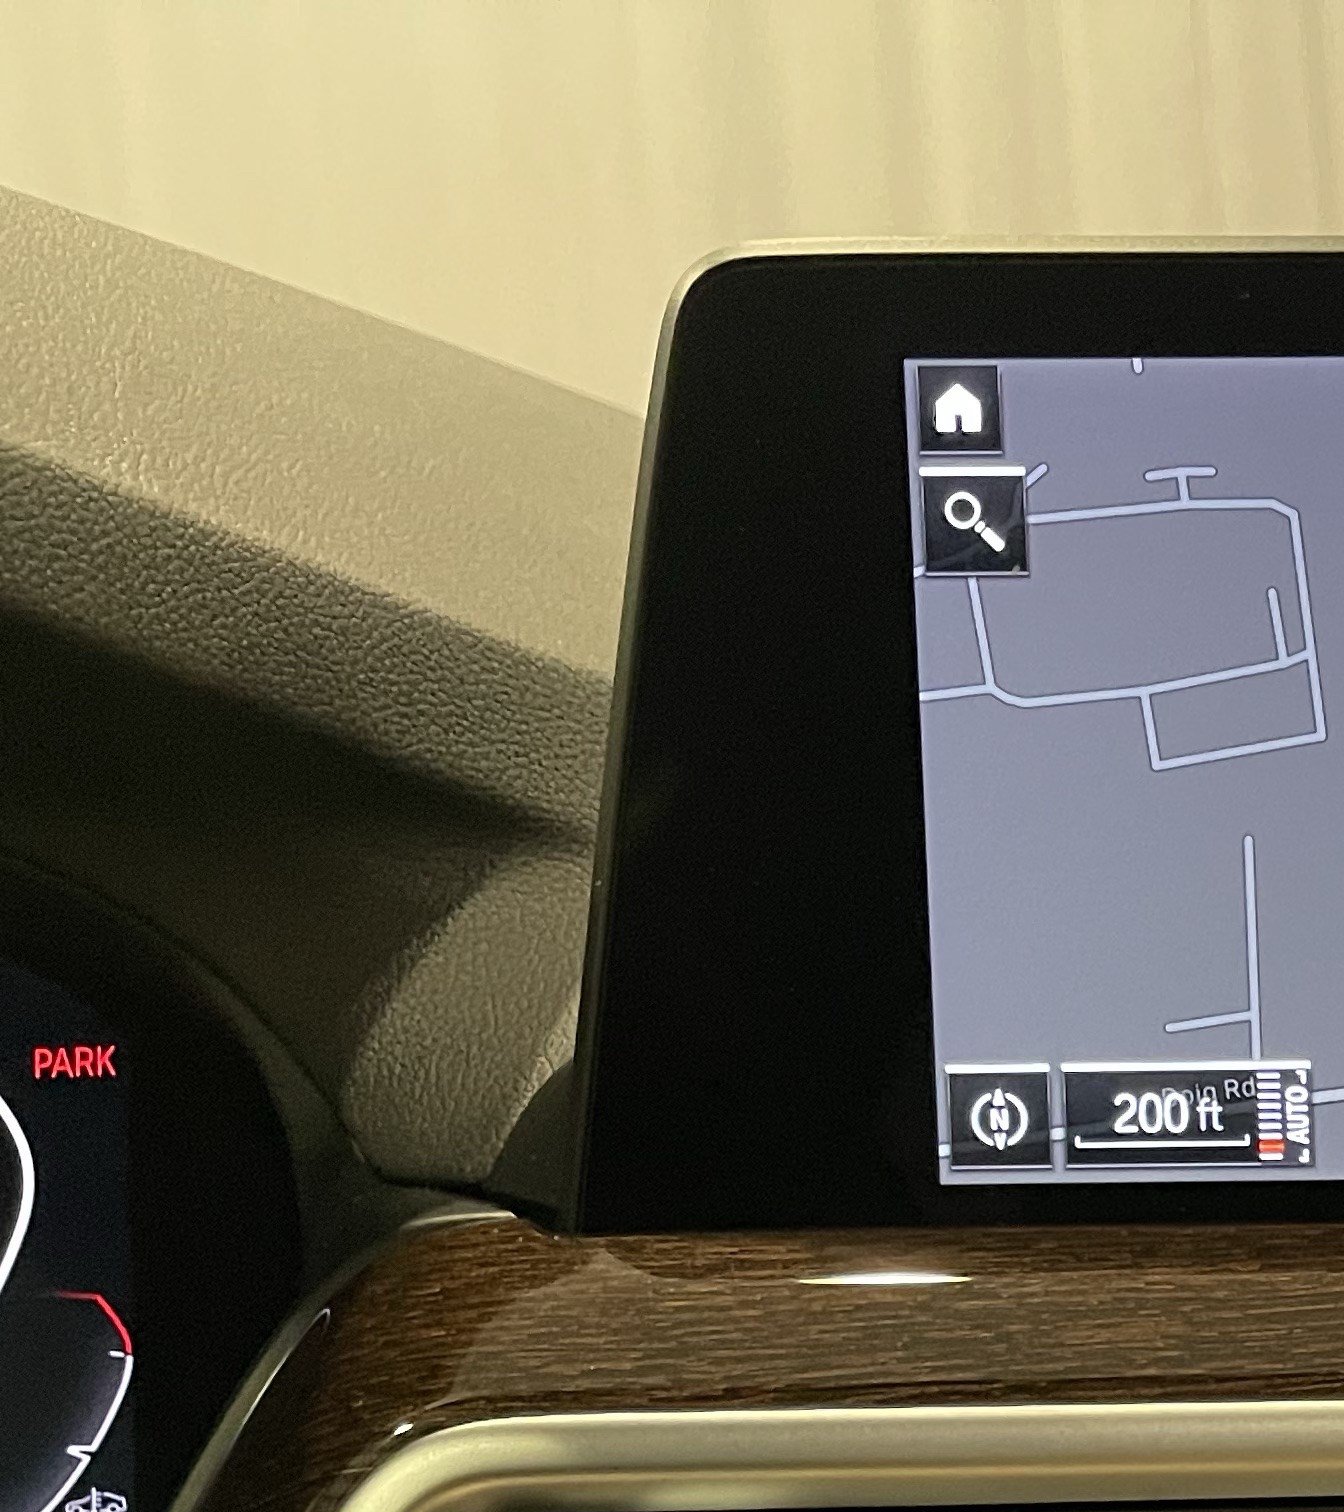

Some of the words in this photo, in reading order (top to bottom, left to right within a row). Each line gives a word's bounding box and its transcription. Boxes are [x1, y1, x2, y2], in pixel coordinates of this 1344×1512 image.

[33, 1045, 117, 1079] PARK
[1223, 1076, 1256, 1100] Rd
[989, 1108, 1010, 1131] N
[1113, 1092, 1189, 1134] 200
[1195, 1096, 1225, 1132] ft
[1285, 1084, 1310, 1145] AUTO
